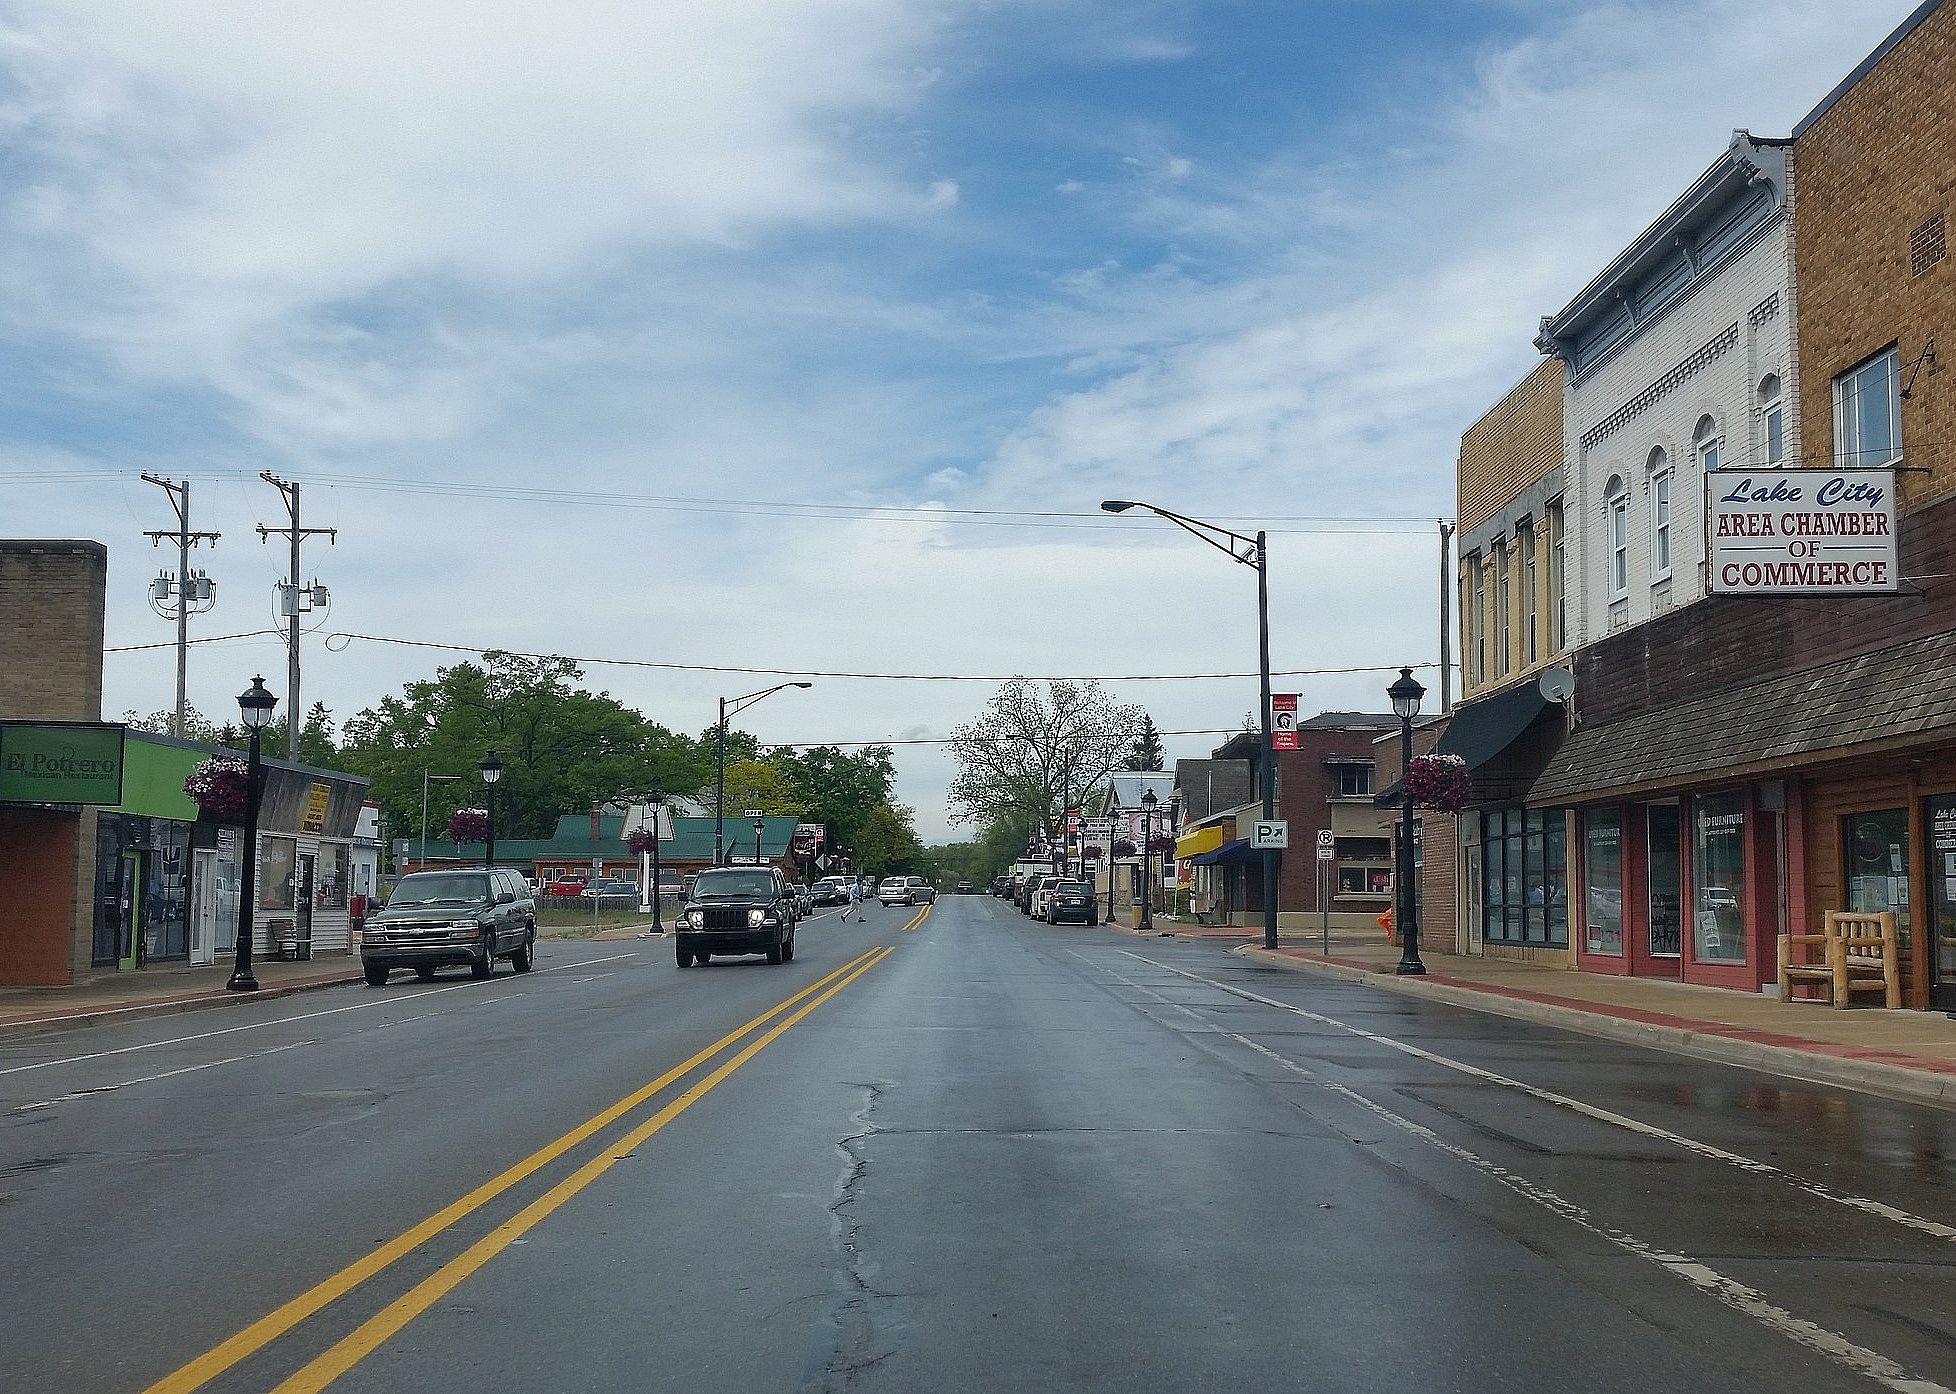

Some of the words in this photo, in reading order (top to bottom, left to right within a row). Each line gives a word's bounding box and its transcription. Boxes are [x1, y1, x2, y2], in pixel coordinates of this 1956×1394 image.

[1720, 478, 1803, 503] Lake
[1816, 477, 1885, 508] City
[1716, 513, 1776, 537] AREA
[1780, 512, 1890, 536] CHAMBER
[1788, 540, 1821, 558] OF
[1721, 561, 1888, 587] COMMERCE
[7, 753, 25, 772] El
[32, 746, 115, 773] Potrero
[63, 770, 114, 780] Restaurant
